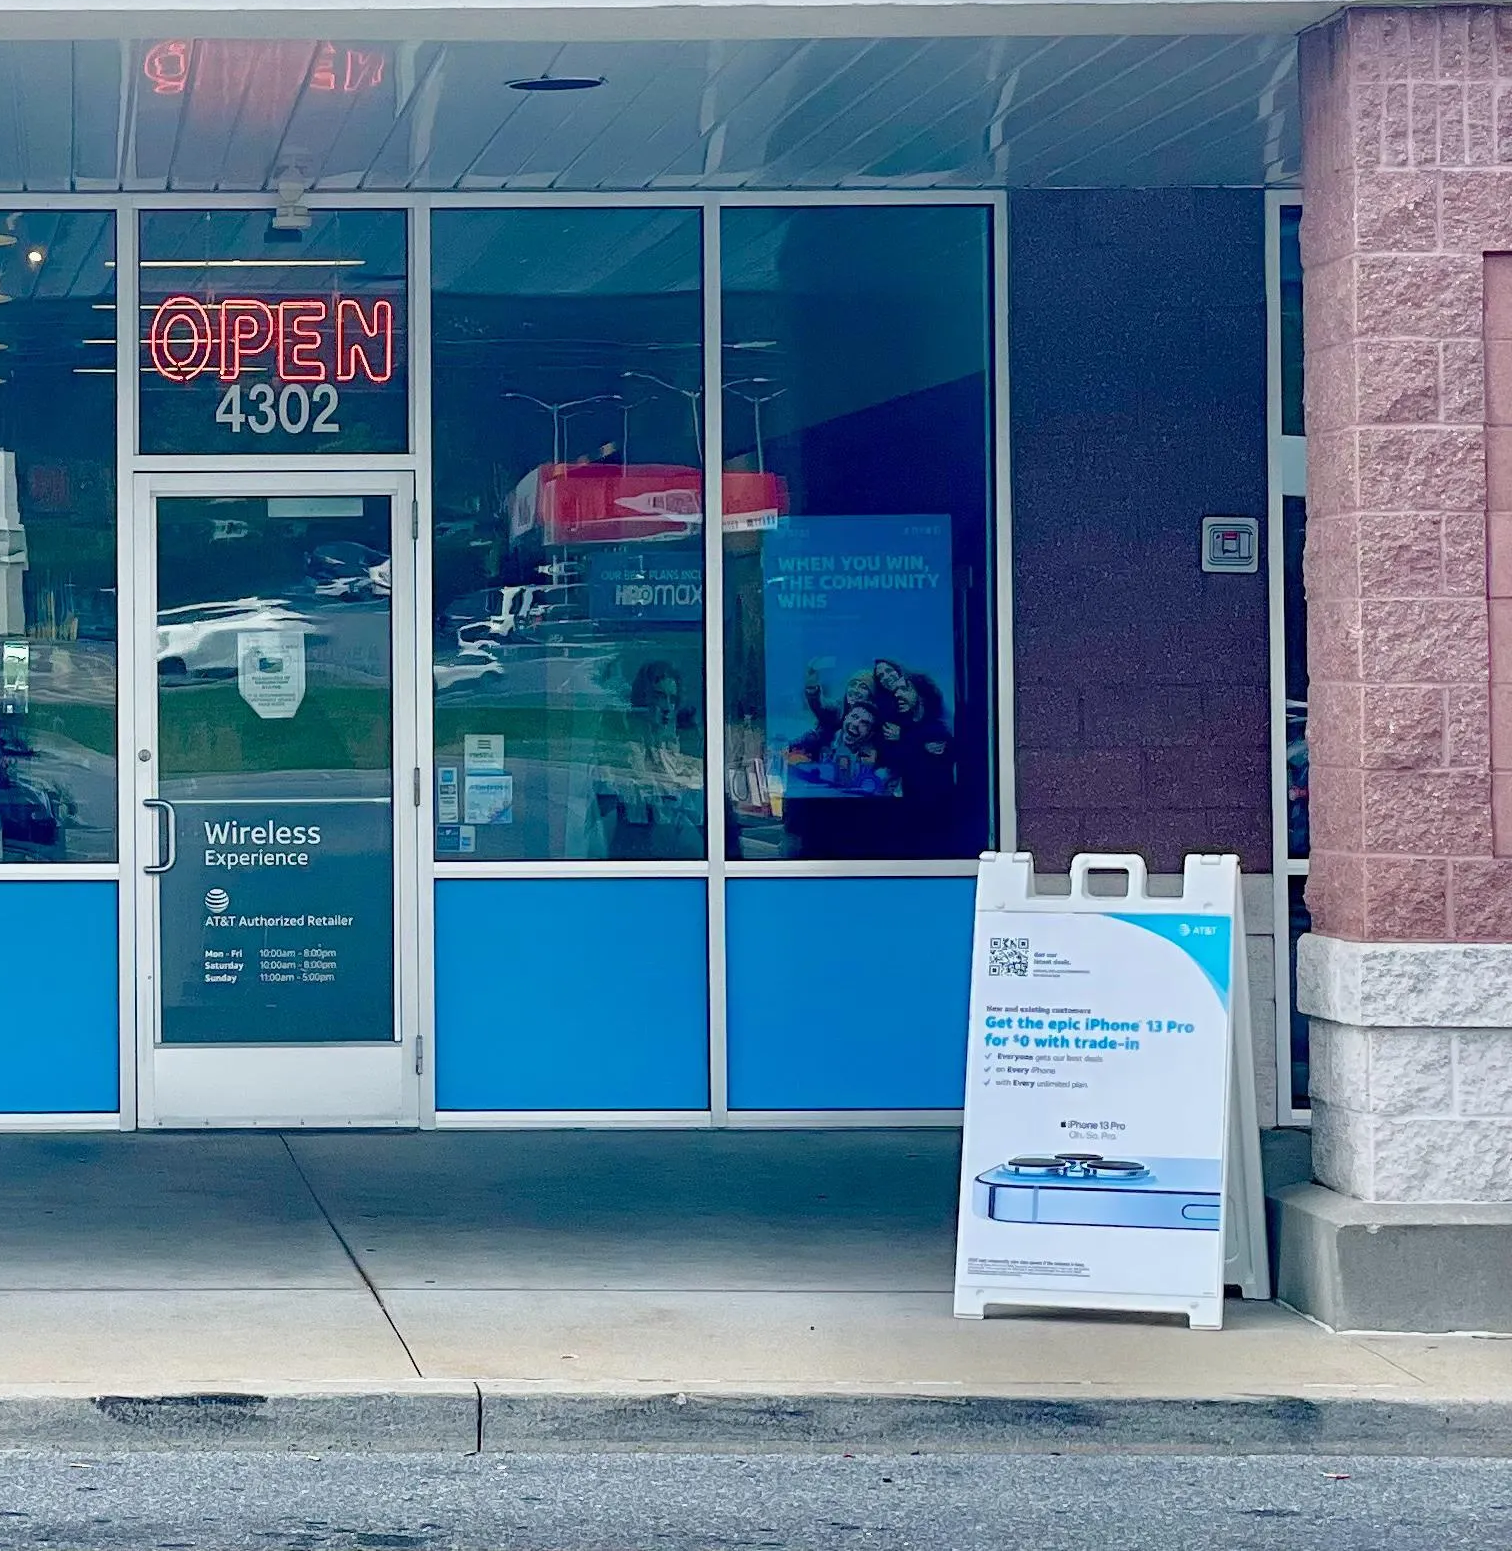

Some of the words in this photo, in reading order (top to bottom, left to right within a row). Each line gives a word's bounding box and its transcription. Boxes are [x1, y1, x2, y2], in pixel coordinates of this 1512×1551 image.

[151, 296, 392, 381] OPEN
[216, 384, 340, 433] 4302
[778, 557, 834, 572] WHEN
[841, 556, 881, 571] YOU
[886, 555, 929, 572] WIN,
[778, 575, 814, 590] THE
[819, 574, 939, 590] COMMUNITY
[778, 594, 827, 608] WINS
[204, 820, 321, 844] Wireless
[205, 849, 308, 869] Experience
[205, 916, 236, 927] AT&T
[239, 915, 305, 927] Authorized
[308, 916, 354, 926] Retailer
[205, 950, 224, 958] Mon
[231, 950, 243, 958] Fri
[205, 962, 244, 971] Saturday
[205, 974, 237, 983] Sunday
[985, 1016, 1012, 1029] Get
[1017, 1016, 1043, 1030] the
[1048, 1017, 1080, 1033] epic
[1085, 1017, 1140, 1032] iPhone
[1146, 1019, 1162, 1032] 13
[1167, 1020, 1195, 1033] Pro
[985, 1033, 1008, 1047] for
[1013, 1034, 1029, 1047] $0
[1034, 1035, 1069, 1048] with
[1074, 1036, 1140, 1050] trade-in
[1008, 1066, 1029, 1075] Every
[1013, 1080, 1034, 1088] Every
[1100, 1121, 1109, 1130] 13
[1111, 1121, 1126, 1131] Pro
